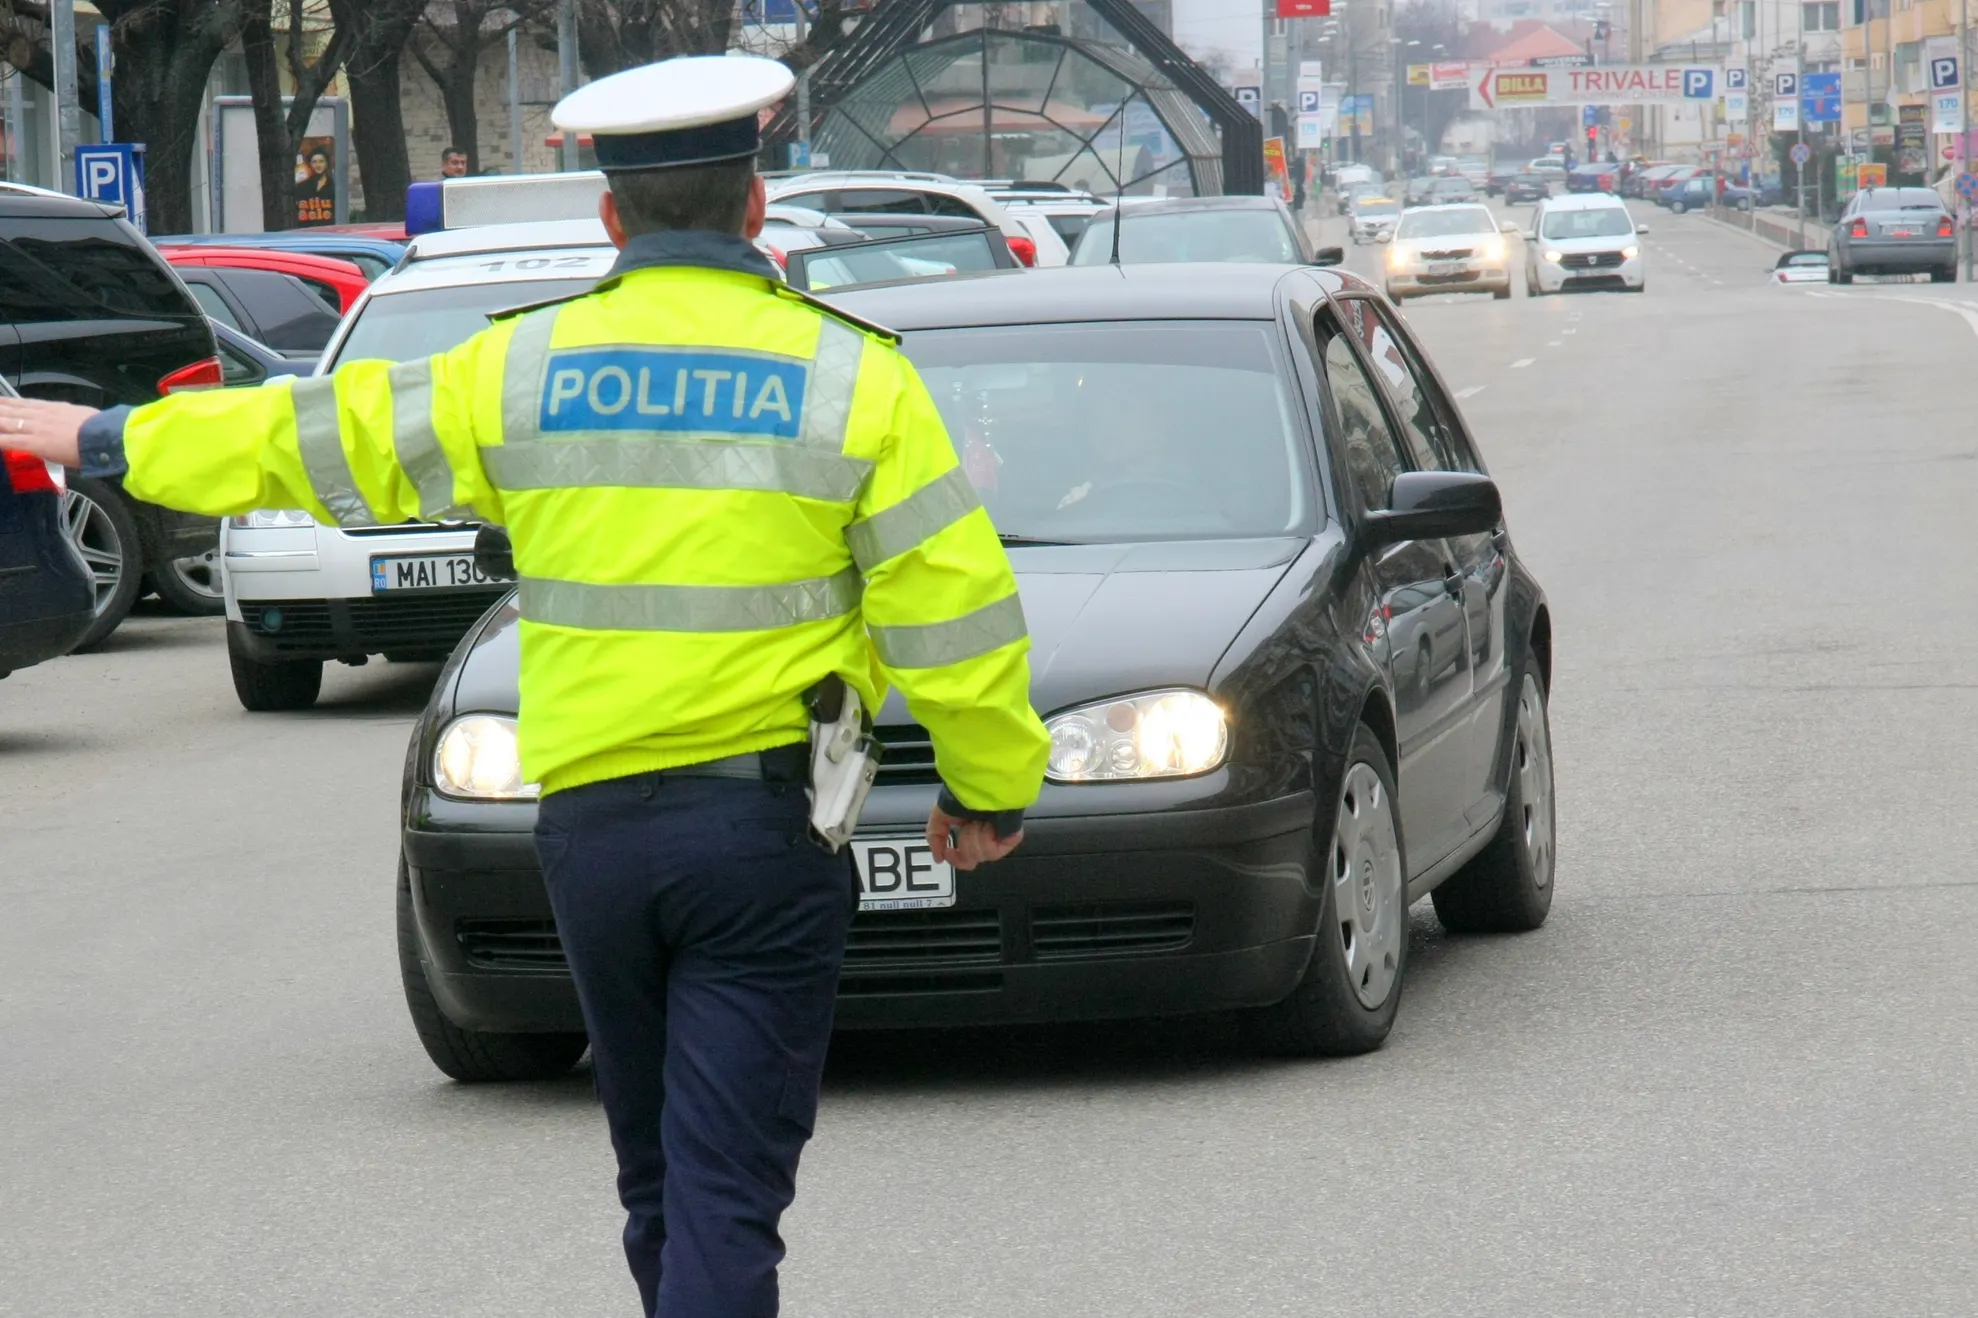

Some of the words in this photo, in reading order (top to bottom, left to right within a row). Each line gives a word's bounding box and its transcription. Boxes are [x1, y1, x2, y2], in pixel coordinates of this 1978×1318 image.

[1499, 76, 1546, 93] BILLA
[1568, 69, 1680, 91] TRIVALE
[1688, 72, 1707, 96] P
[1728, 70, 1742, 88] P
[1778, 74, 1794, 95] P
[1935, 60, 1955, 86] P
[1301, 92, 1317, 111] P
[1938, 97, 1959, 109] 170
[89, 161, 116, 198] P
[480, 257, 591, 272] 102
[548, 365, 792, 422] POLITIA
[374, 577, 386, 588] RO
[397, 560, 437, 588] MAI
[853, 846, 940, 893] BE
